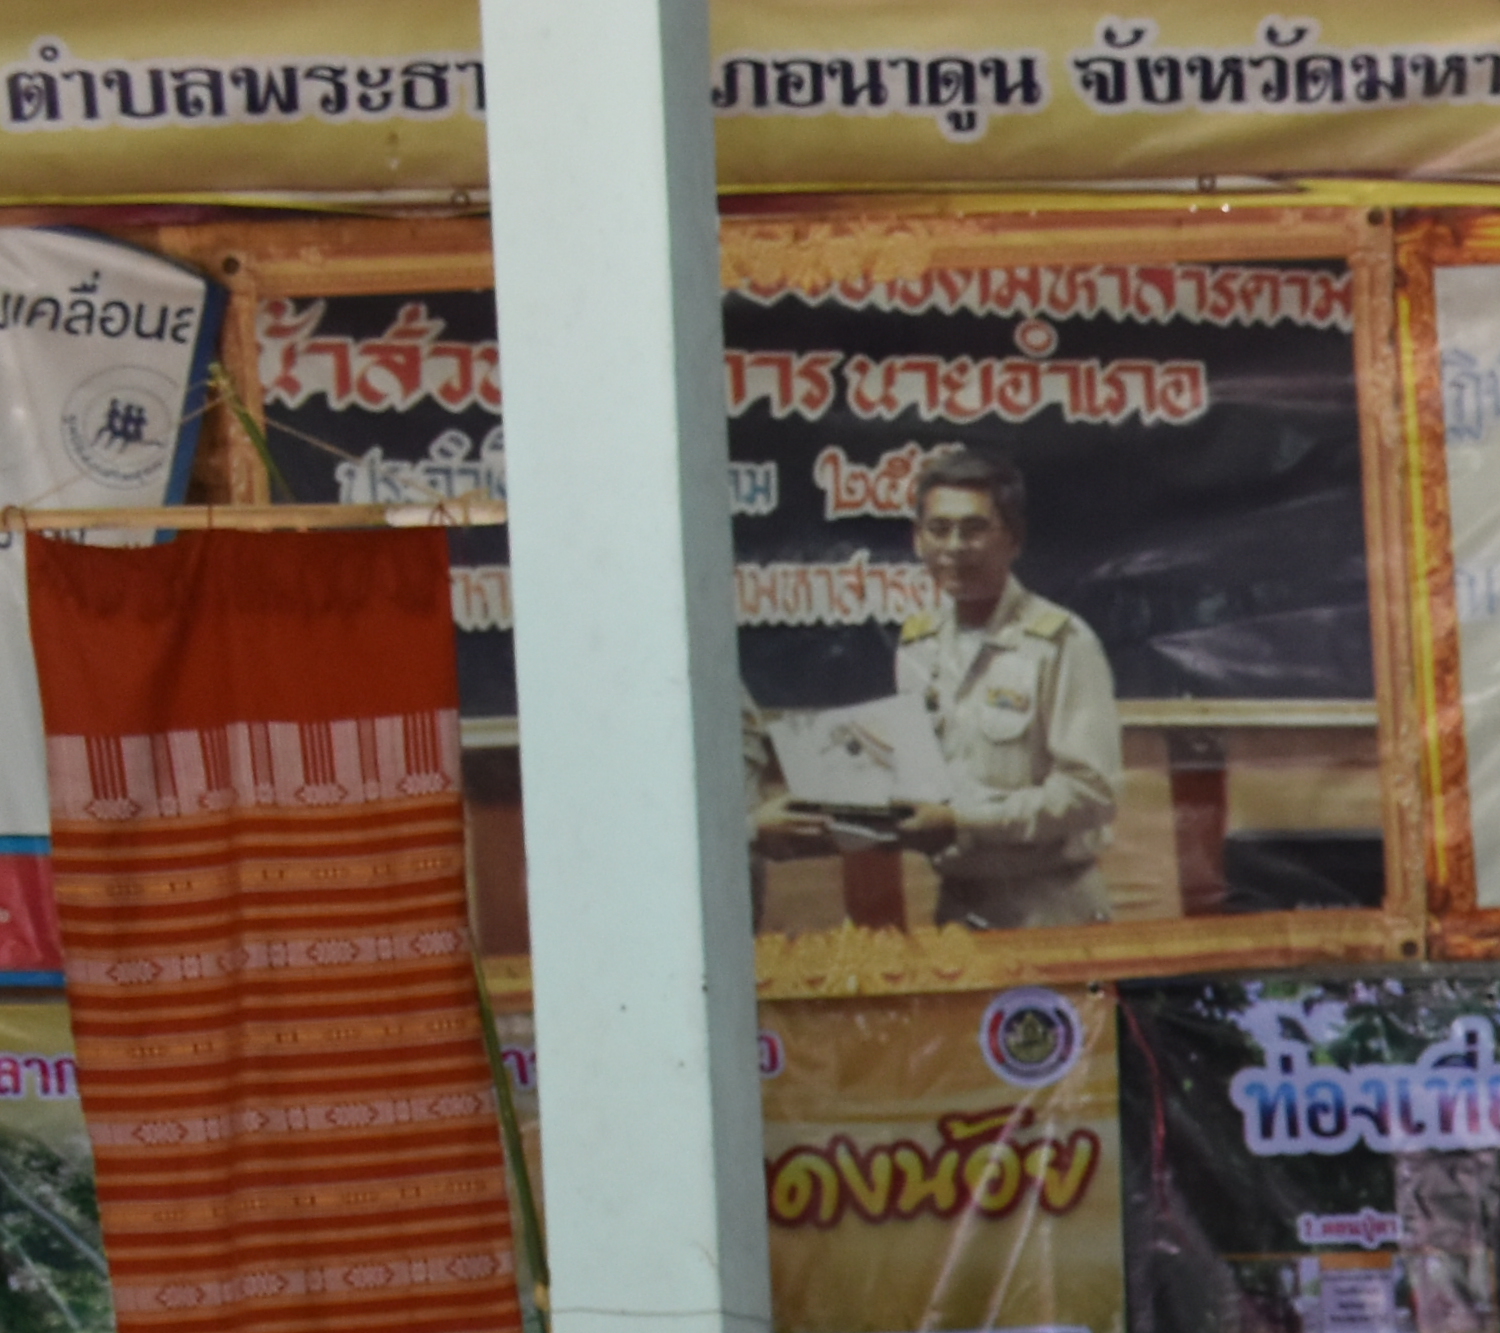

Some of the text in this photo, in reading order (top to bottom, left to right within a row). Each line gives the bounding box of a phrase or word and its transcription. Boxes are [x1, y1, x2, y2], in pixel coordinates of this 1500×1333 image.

[5, 46, 486, 124] ตำบลพระธา
[710, 52, 1041, 131] ภอนาดูน
[850, 322, 1206, 419] นายอำเภอ
[768, 1106, 1101, 1229] ดงน้อย
